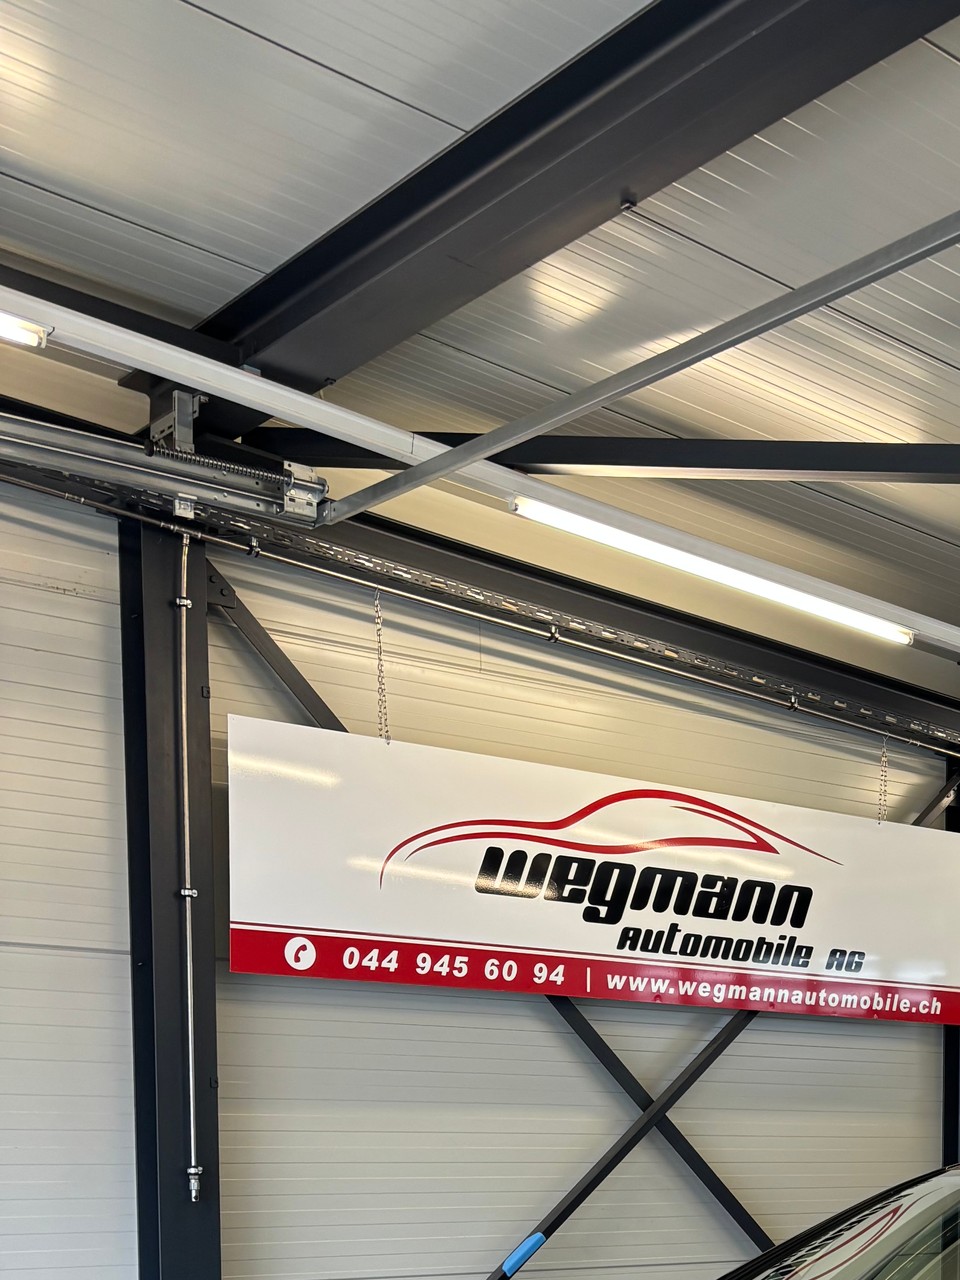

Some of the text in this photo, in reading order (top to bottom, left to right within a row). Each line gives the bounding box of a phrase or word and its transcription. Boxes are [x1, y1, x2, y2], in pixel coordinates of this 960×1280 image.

[474, 846, 814, 928] wegmann
[342, 946, 942, 1015] 044 945 60 94 www.wegmannautomobile.ch
[825, 948, 866, 972] AG
